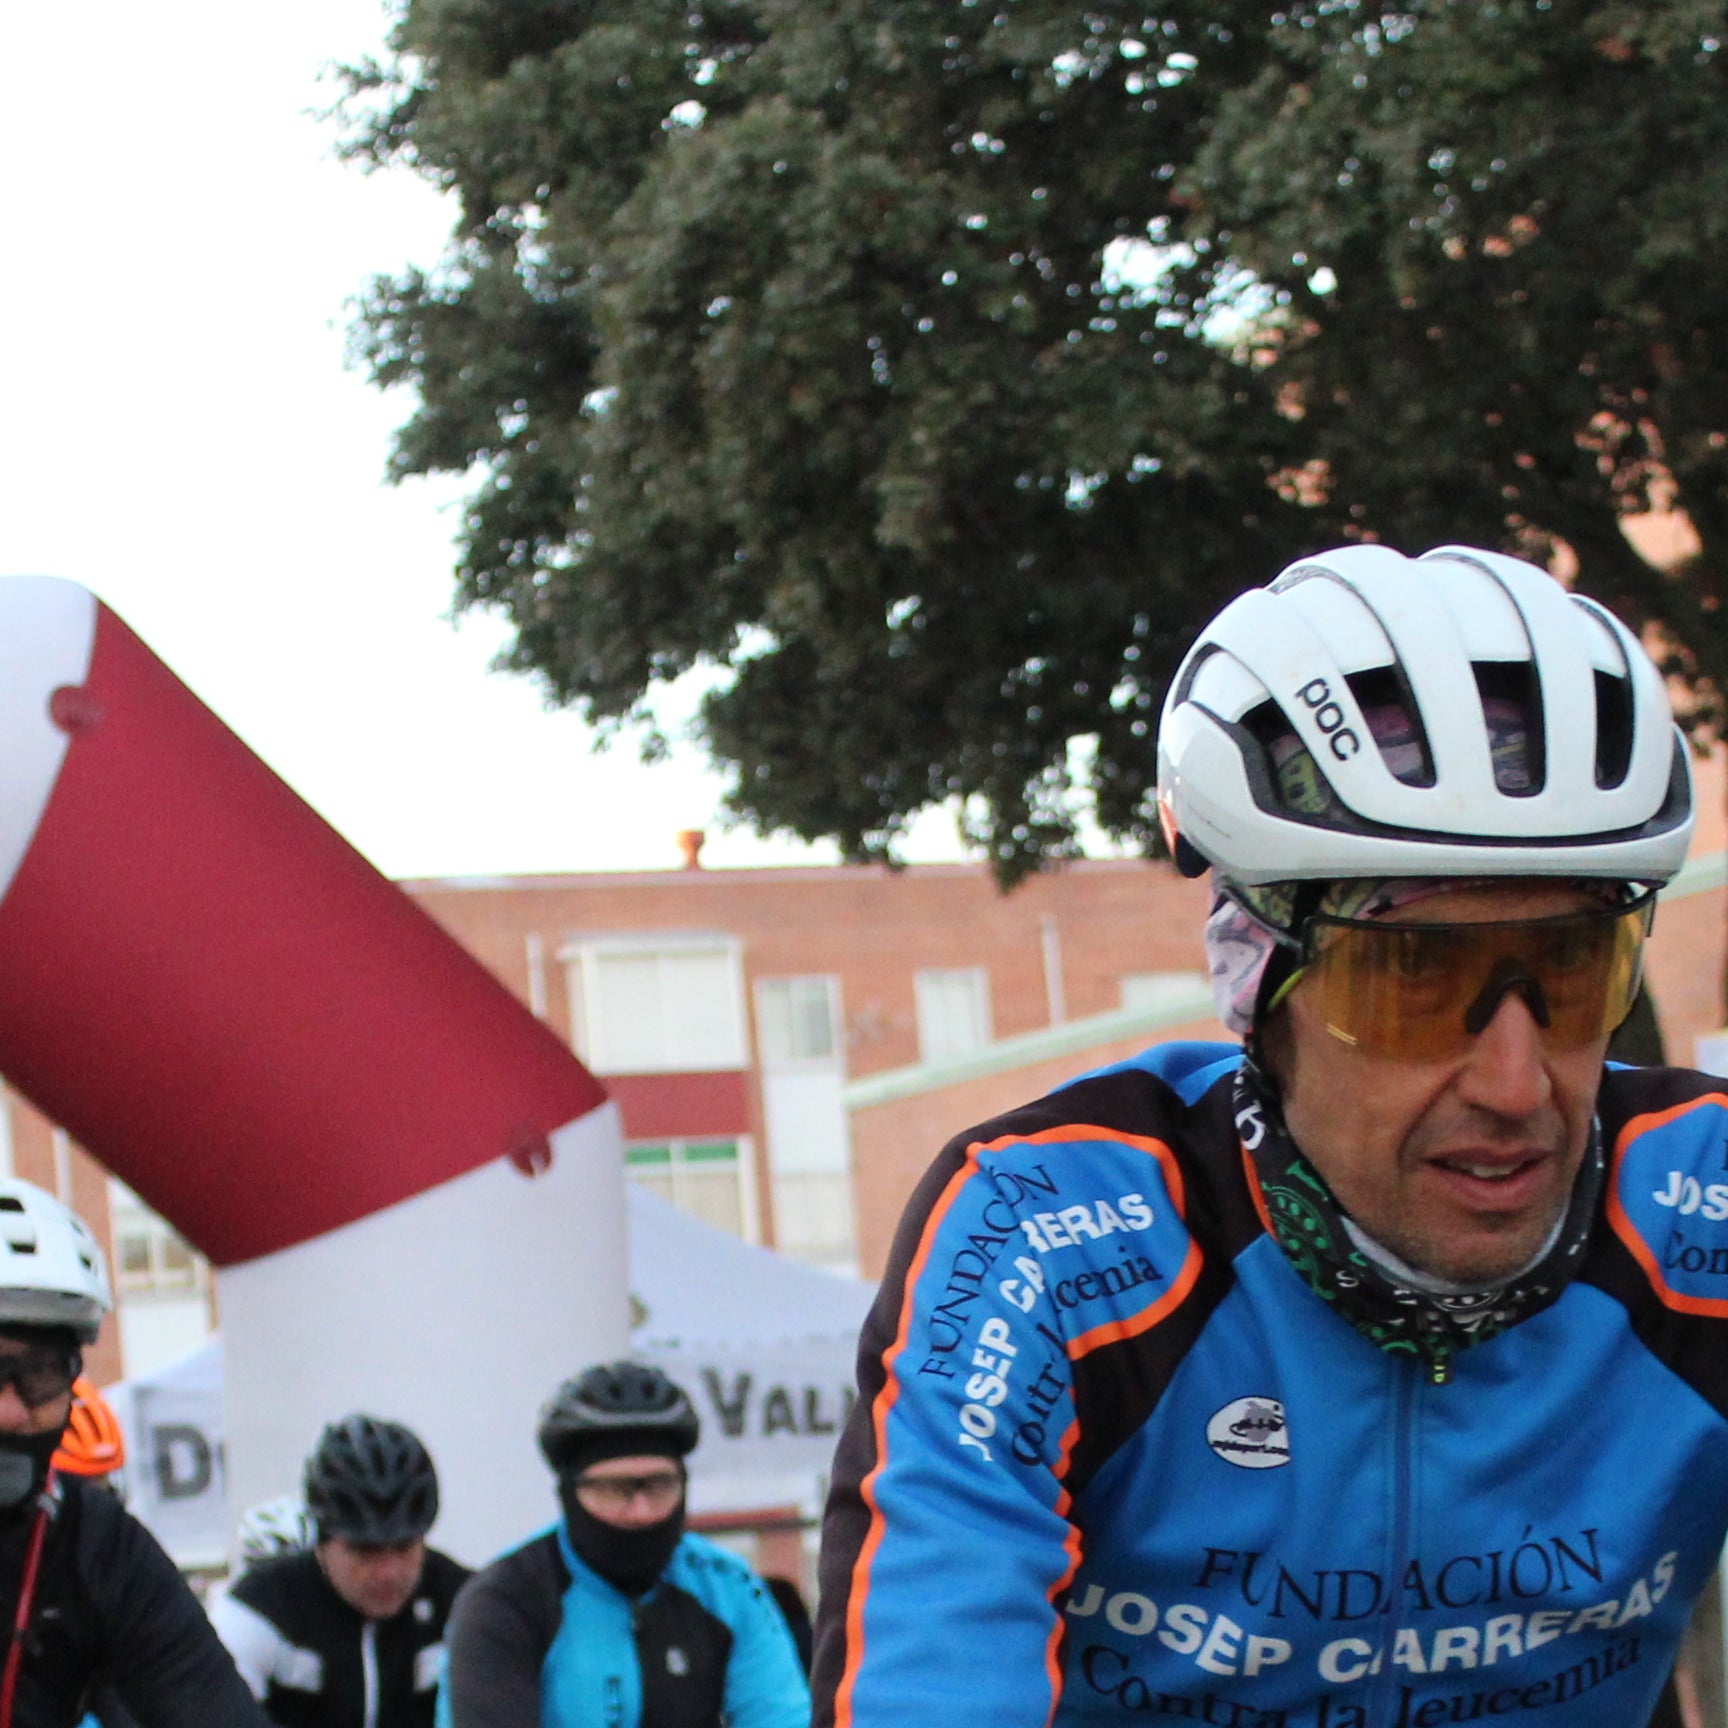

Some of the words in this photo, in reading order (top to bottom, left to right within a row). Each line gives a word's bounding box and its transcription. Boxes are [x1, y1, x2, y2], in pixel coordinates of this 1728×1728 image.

[1065, 1583, 1293, 1678] JOSEP
[1316, 1550, 1679, 1683] CARRERAS
[1192, 1524, 1605, 1623] FUNDACIÓN
